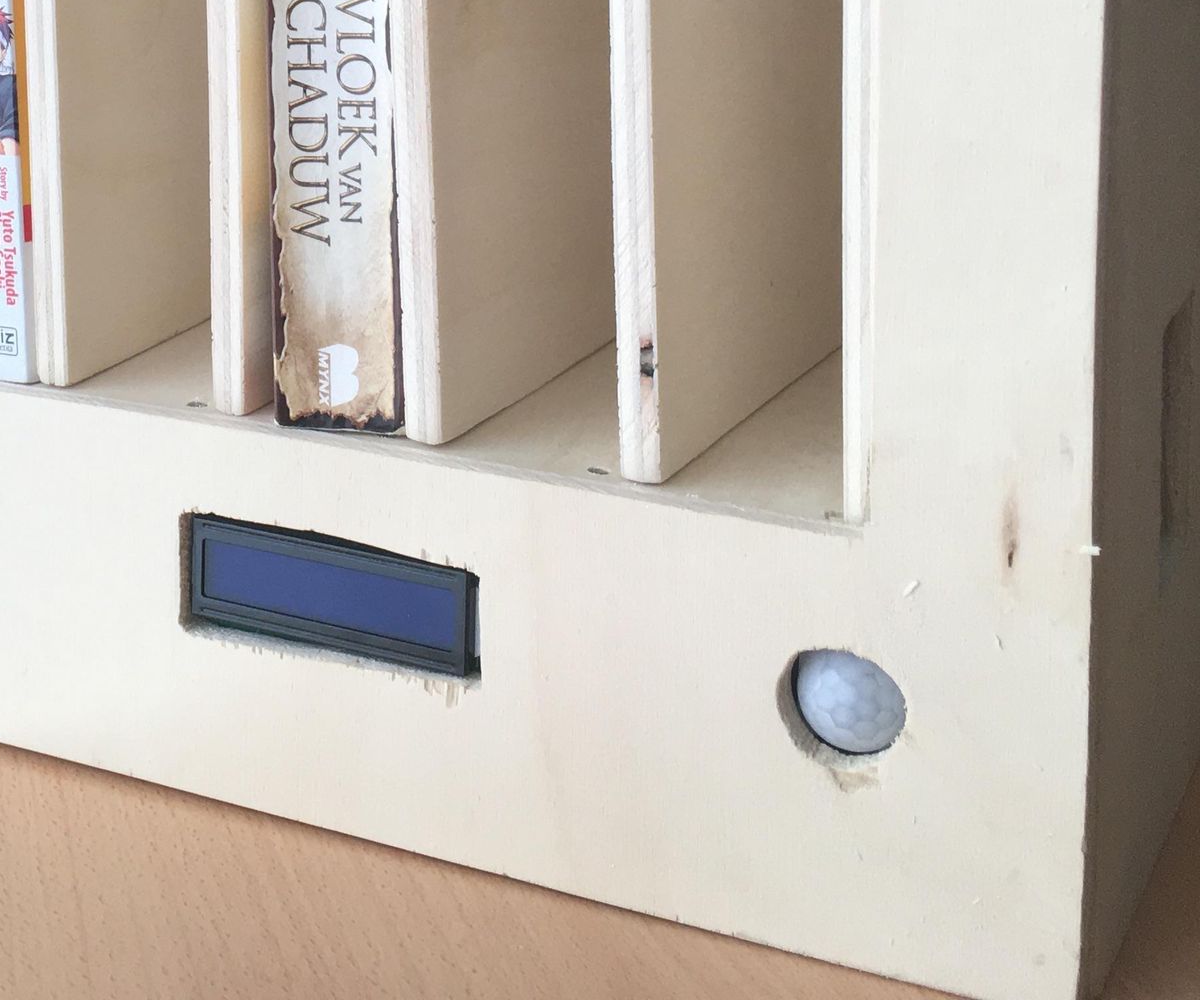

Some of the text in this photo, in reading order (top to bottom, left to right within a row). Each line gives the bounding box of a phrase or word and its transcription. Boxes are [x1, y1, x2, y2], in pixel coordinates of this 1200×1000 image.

[338, 162, 363, 224] VAN
[0, 166, 19, 306] Story by Yuto Tsukuda
[317, 351, 331, 407] MYNX
